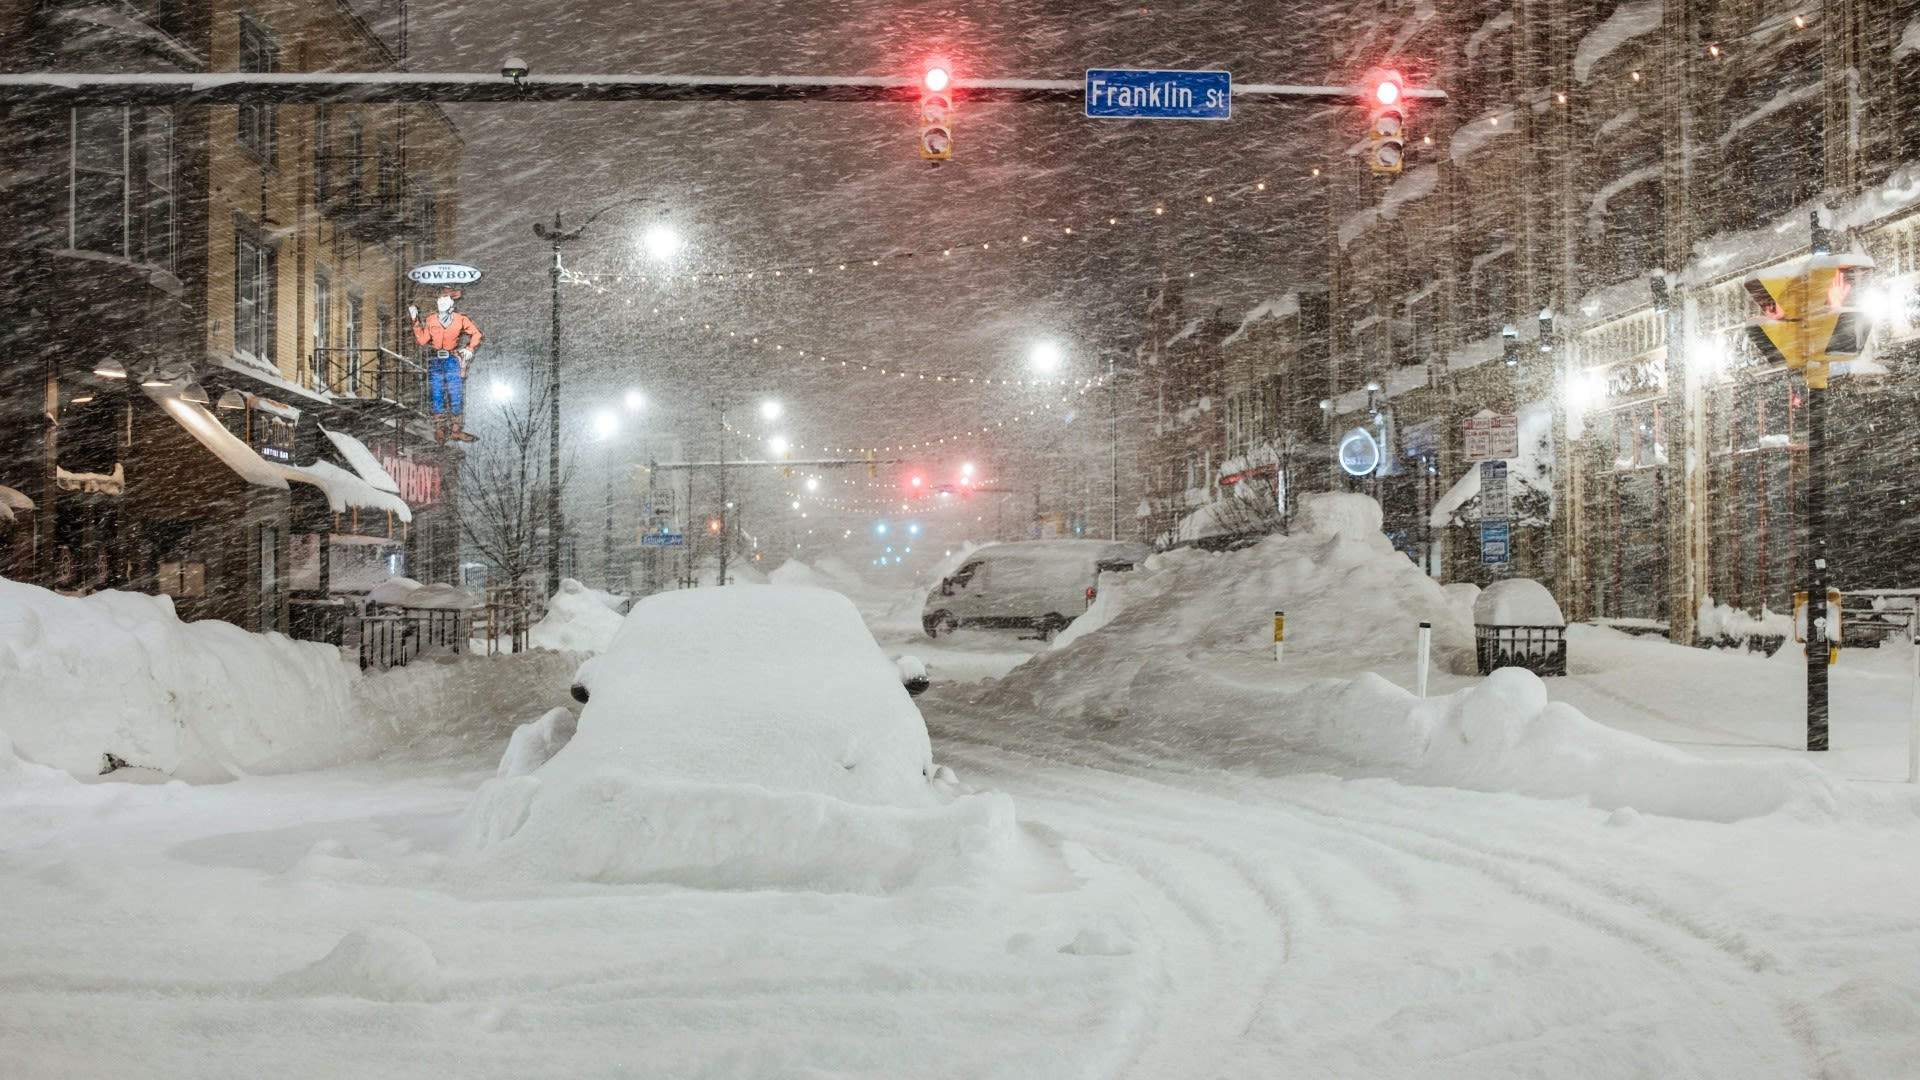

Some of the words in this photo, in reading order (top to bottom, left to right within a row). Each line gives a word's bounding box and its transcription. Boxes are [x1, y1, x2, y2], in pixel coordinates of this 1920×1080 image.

[1092, 80, 1192, 108] Franklin
[1206, 88, 1225, 108] St
[411, 270, 477, 280] COWBOY
